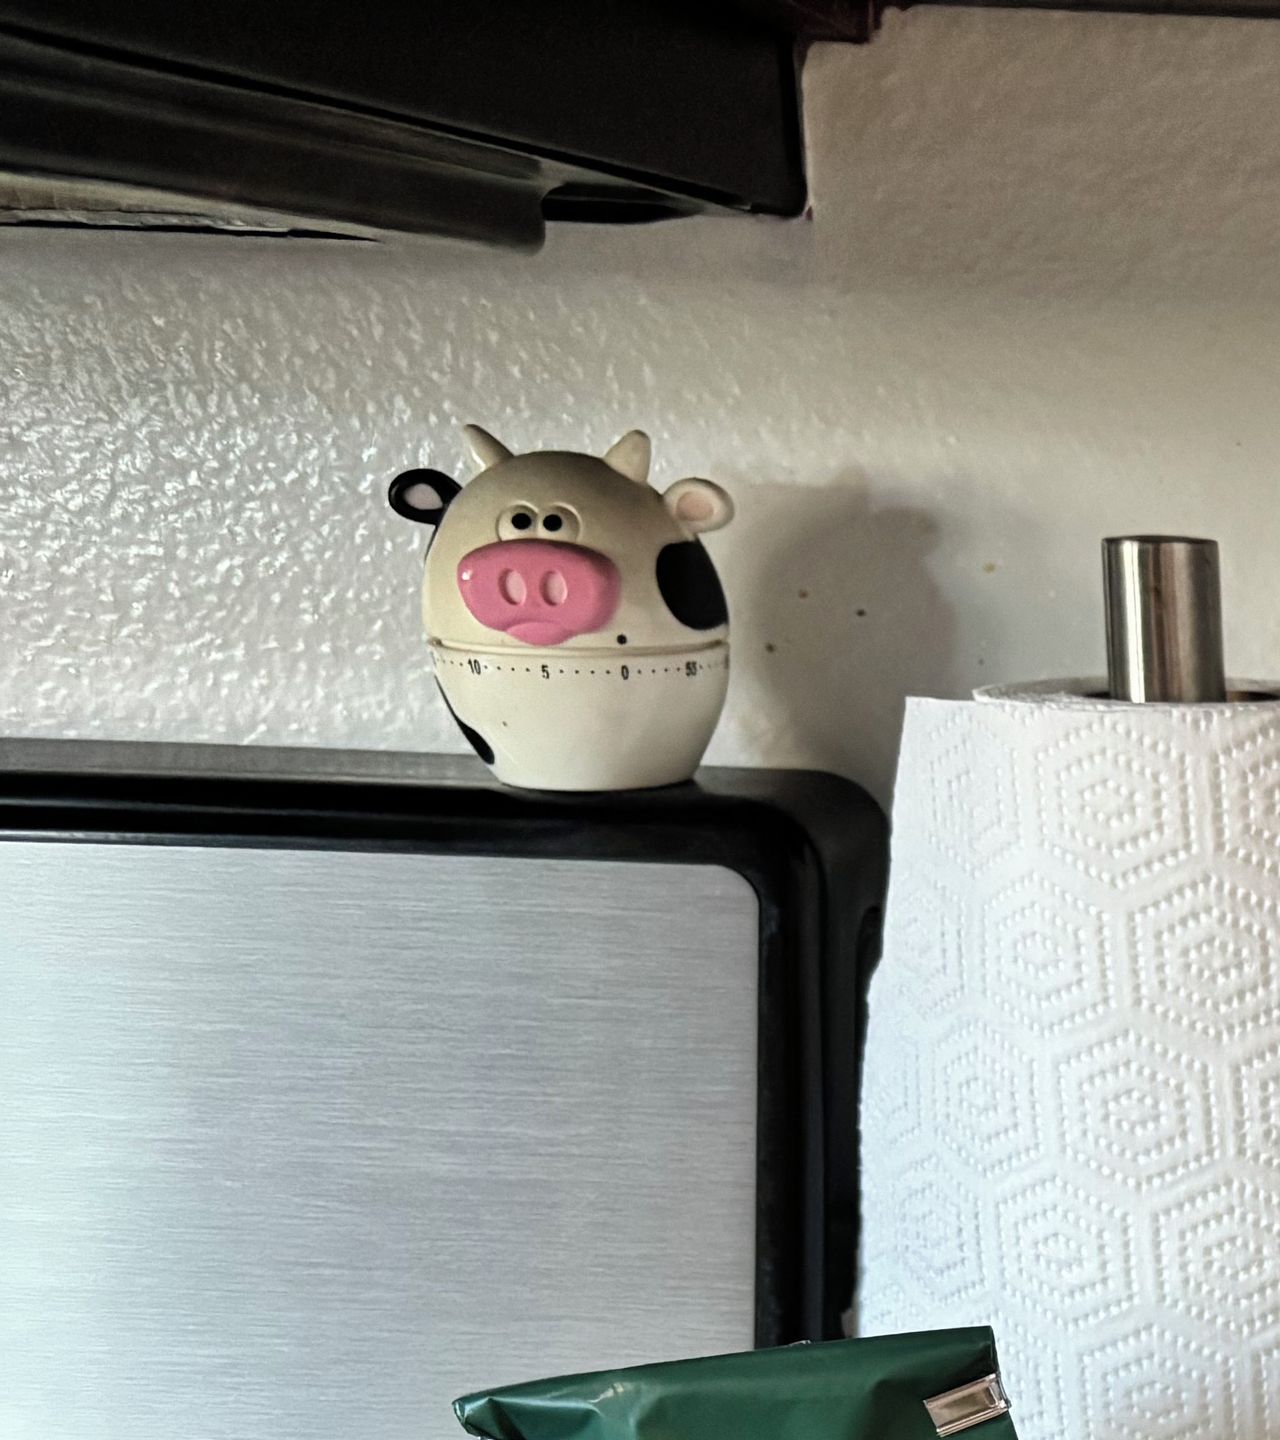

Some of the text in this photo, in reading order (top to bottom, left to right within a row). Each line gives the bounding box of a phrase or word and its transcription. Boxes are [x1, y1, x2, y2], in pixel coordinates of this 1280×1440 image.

[467, 658, 481, 675] 10
[541, 664, 550, 679] 5
[621, 664, 630, 680] 0
